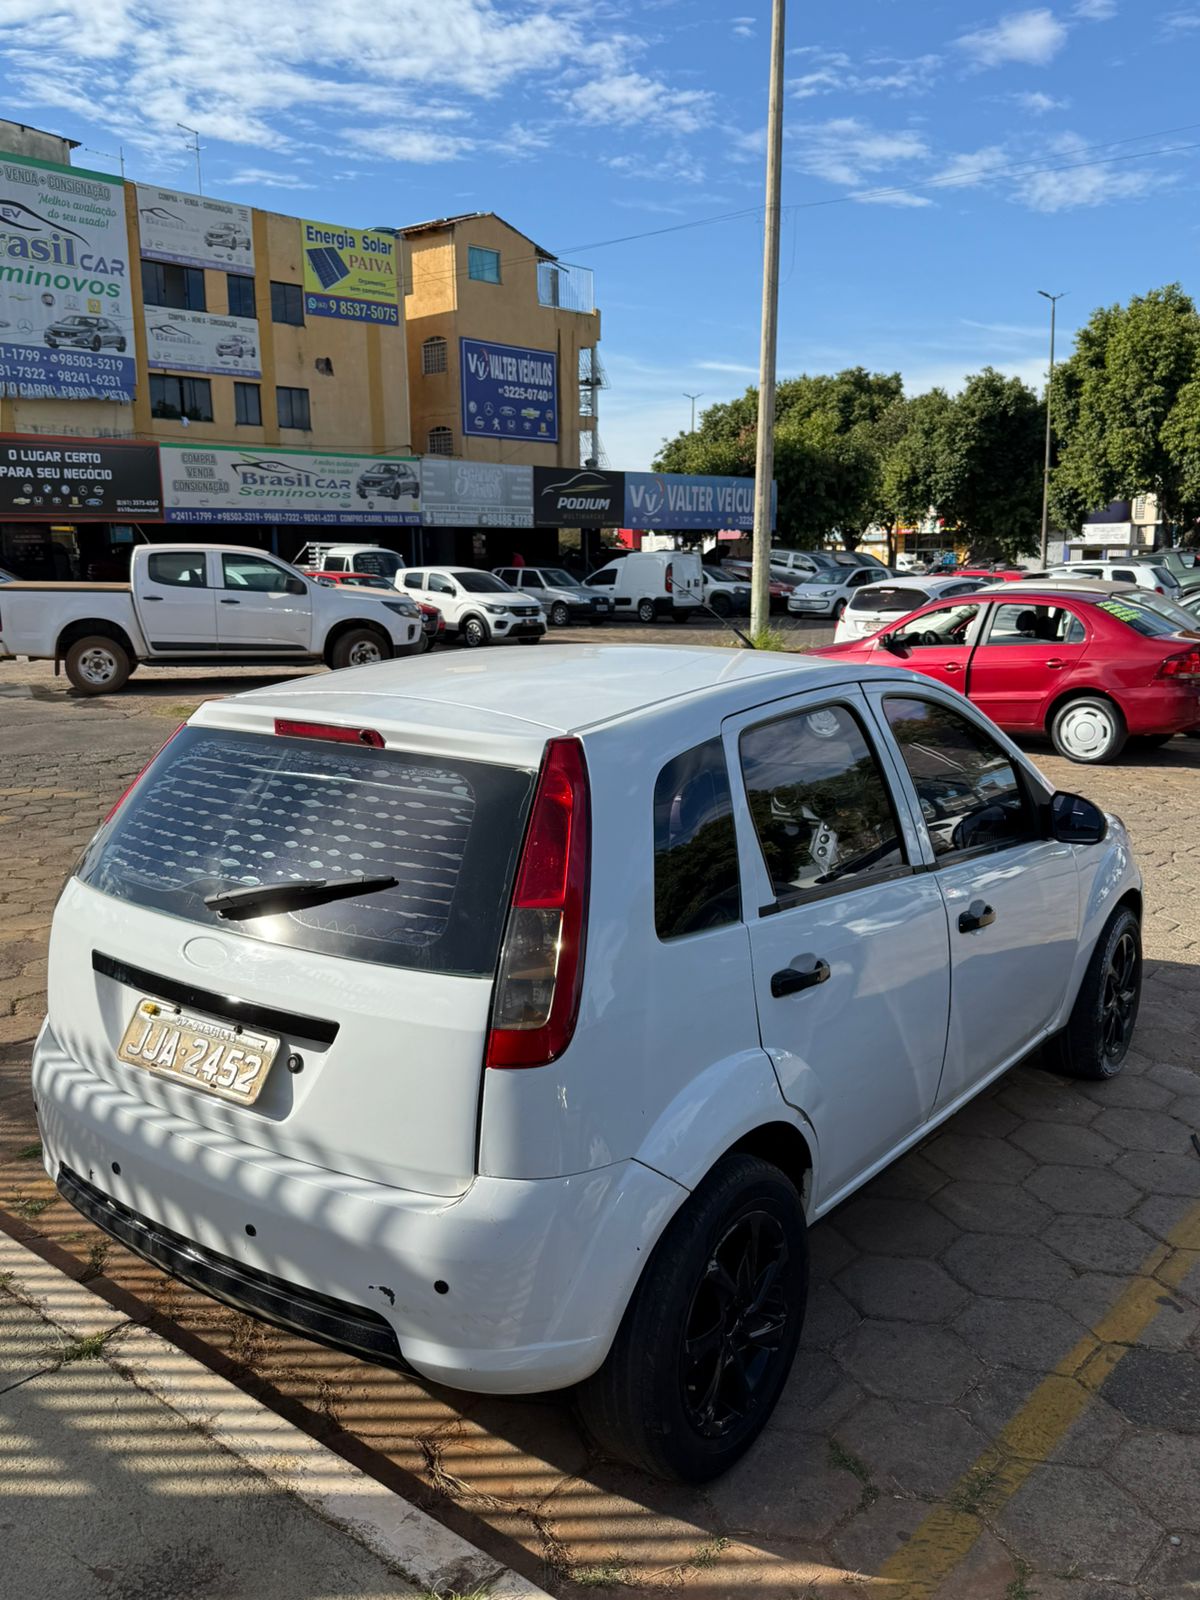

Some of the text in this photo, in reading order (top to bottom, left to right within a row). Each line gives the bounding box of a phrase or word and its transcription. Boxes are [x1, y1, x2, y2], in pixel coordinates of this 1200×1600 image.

[5, 166, 111, 201] VENDA CONSIGNAÇÃO
[2, 208, 21, 218] EV
[47, 209, 60, 219] do
[62, 213, 76, 223] seu
[306, 225, 393, 256] Energia Solar
[80, 254, 125, 277] CAR
[348, 254, 394, 275] PAIVA
[329, 300, 337, 313] 9
[340, 301, 397, 321] 8537-5075
[489, 354, 518, 382] VALTER
[518, 354, 553, 387] VEÍCULOS
[504, 385, 548, 402] 3225-0740
[8, 449, 102, 464] O LUGAR CERTO
[181, 452, 218, 466] COMPRA
[0, 465, 113, 480] PARA SEU NEGÓCIO
[185, 466, 216, 479] VENDA
[242, 472, 351, 489] Brasil CAR
[173, 478, 231, 495] CONSIGNAÇÃO
[239, 486, 351, 499] Seminovos
[557, 497, 611, 510] PODIUM
[667, 484, 713, 512] VALTER
[717, 481, 755, 513] VEÍCU
